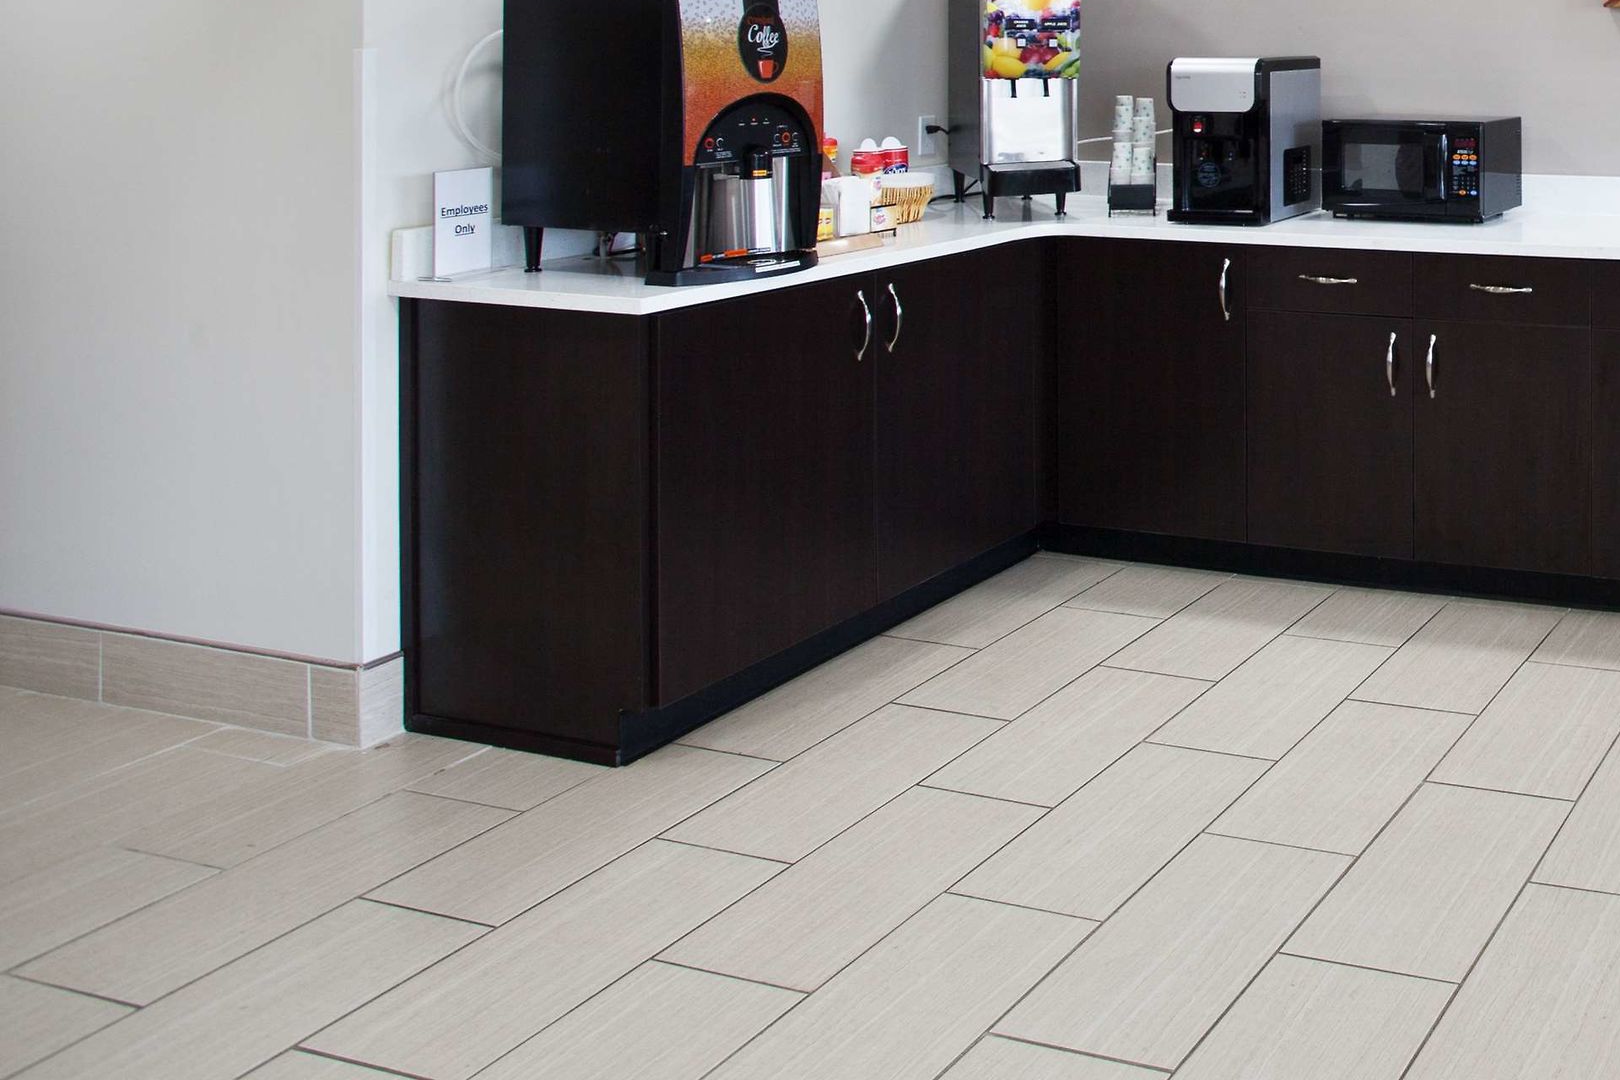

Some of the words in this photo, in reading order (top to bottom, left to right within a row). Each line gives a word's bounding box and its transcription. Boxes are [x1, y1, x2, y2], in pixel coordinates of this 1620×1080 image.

[747, 23, 780, 50] Coffee
[441, 204, 489, 218] Employees
[455, 224, 475, 236] Only
